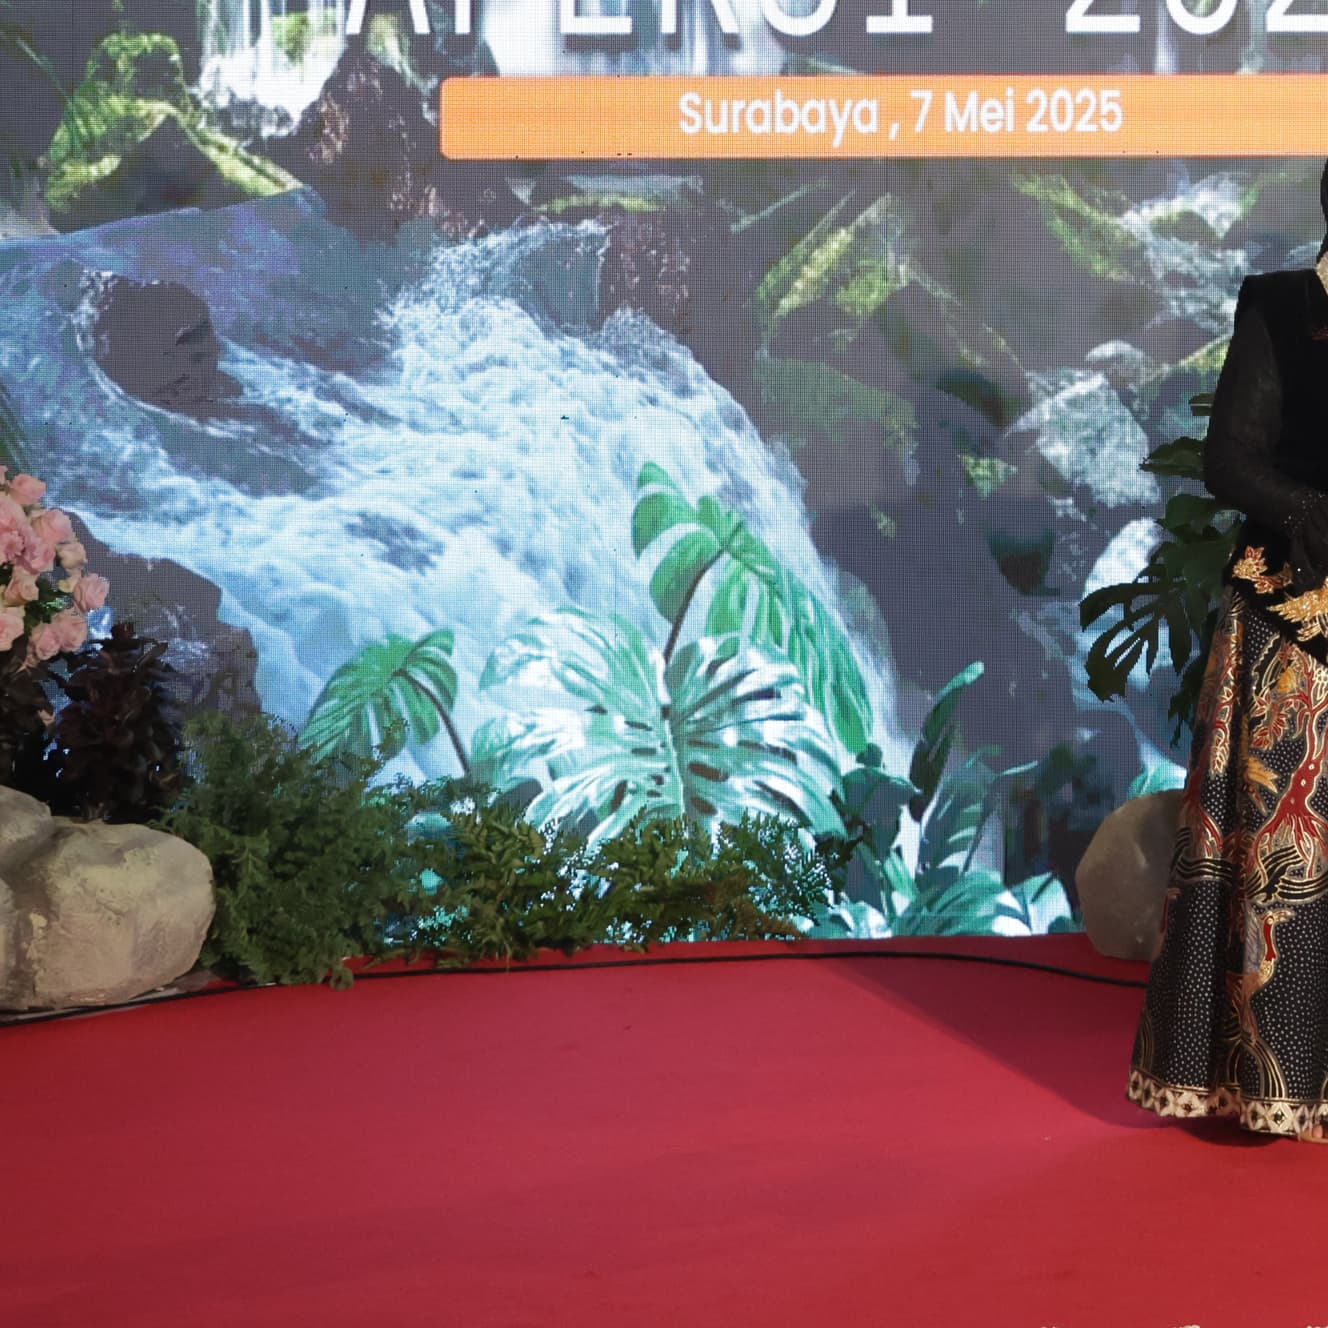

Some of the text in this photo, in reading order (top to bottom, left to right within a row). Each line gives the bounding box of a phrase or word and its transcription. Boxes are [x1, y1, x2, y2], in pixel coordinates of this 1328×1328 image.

[910, 89, 934, 133] 7
[944, 87, 1015, 133] Mei
[1025, 87, 1124, 133] 2025
